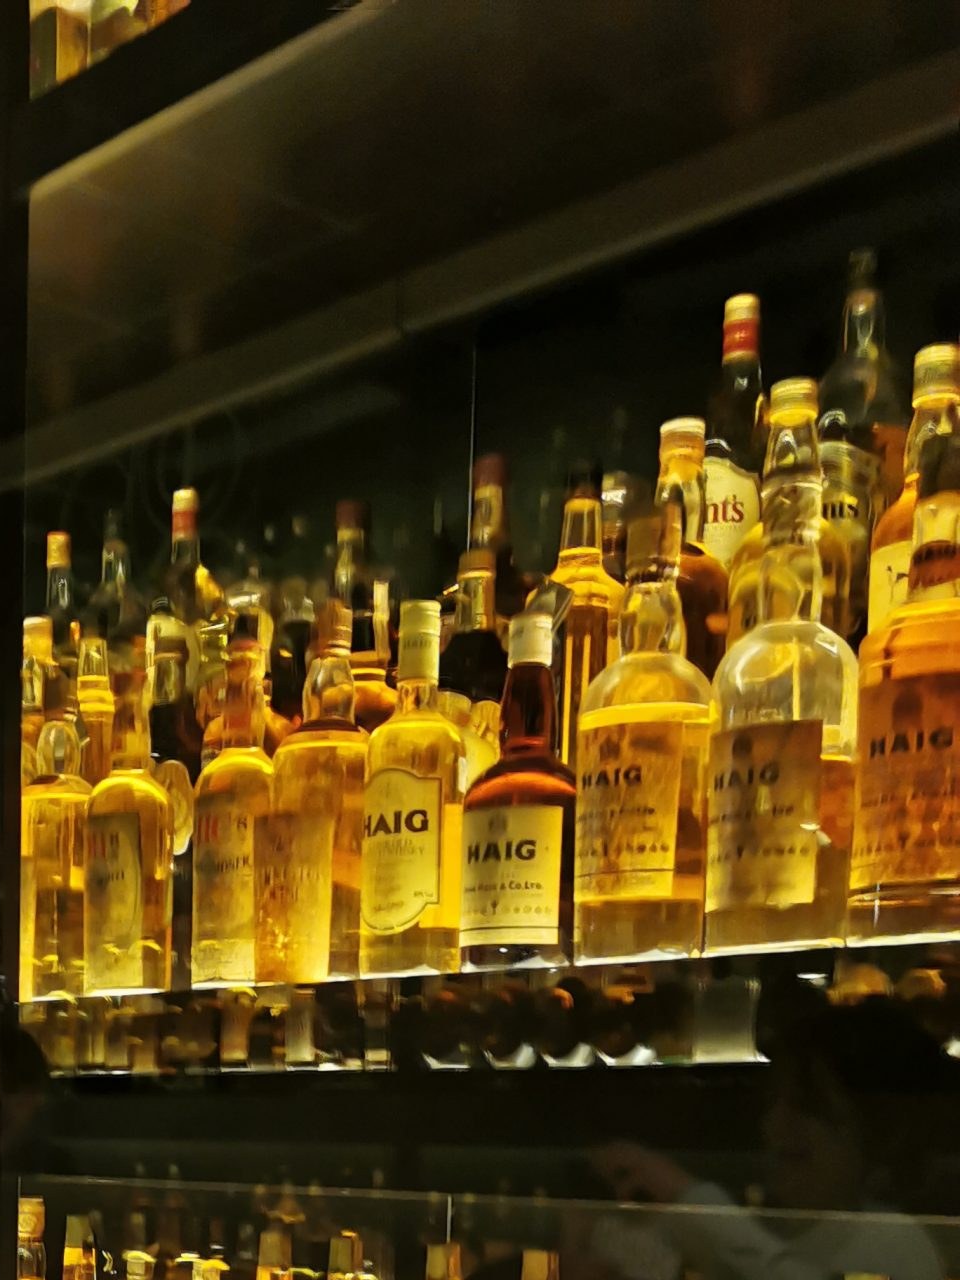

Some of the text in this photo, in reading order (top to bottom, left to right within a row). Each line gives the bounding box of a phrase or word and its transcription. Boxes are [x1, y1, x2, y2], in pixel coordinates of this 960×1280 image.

[706, 494, 745, 524] nt's
[869, 727, 954, 759] HAIG
[582, 764, 642, 788] HAIG
[714, 761, 780, 792] HAIG
[364, 809, 430, 838] HAIG
[467, 839, 537, 865] HAIG
